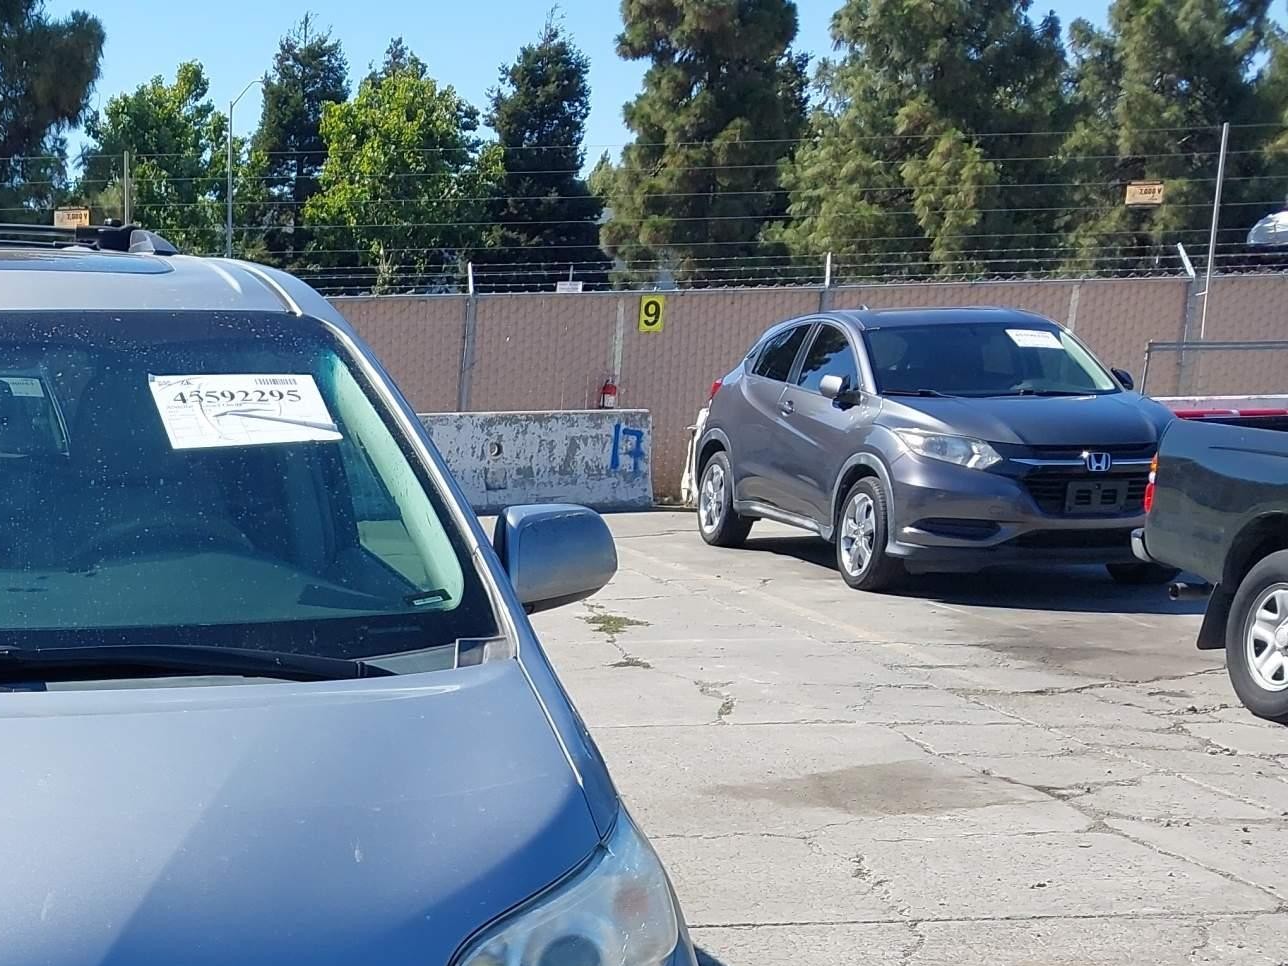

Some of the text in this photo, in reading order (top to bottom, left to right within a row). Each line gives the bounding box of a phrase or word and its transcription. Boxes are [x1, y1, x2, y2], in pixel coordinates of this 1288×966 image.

[643, 300, 661, 327] 9
[172, 388, 302, 405] 45592295
[609, 422, 645, 473] 17
